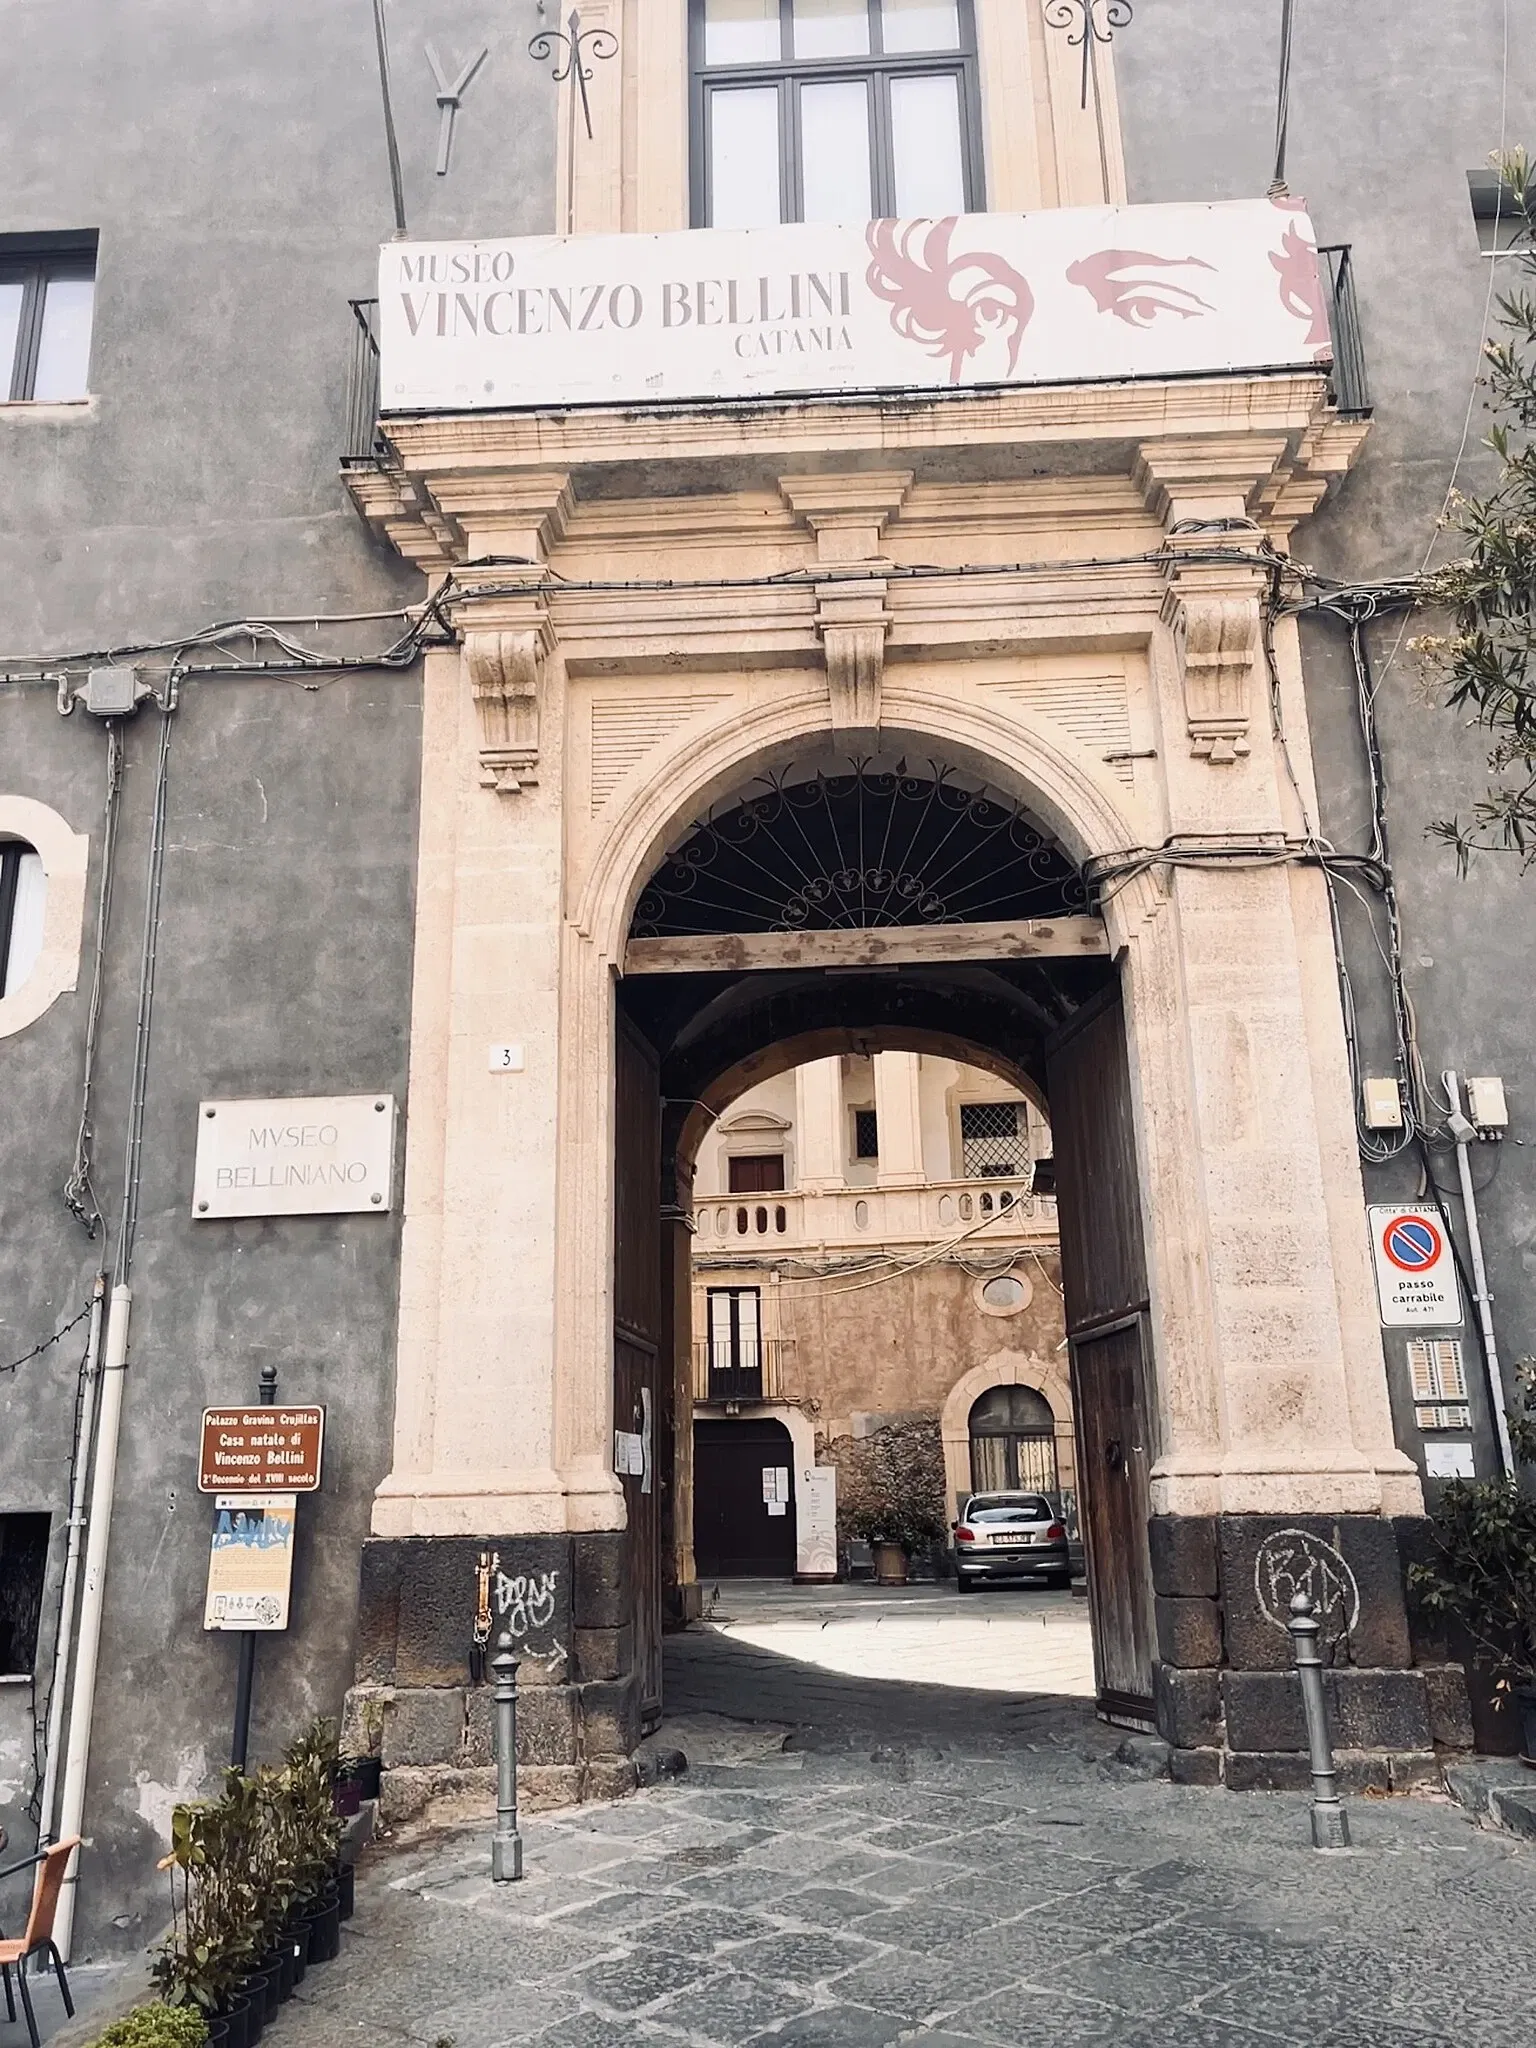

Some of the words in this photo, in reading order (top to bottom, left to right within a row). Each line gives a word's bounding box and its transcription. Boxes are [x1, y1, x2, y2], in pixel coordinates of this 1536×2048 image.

[400, 250, 515, 283] MUSEO
[400, 283, 643, 337] VINCENZO
[661, 271, 851, 328] BELLINI
[734, 325, 854, 359] CATANIA
[503, 1049, 511, 1066] 3
[249, 1125, 338, 1149] MVSEO
[216, 1162, 367, 1189] BELLINIANO
[1398, 1281, 1434, 1290] passo
[1392, 1293, 1444, 1303] carrabile
[206, 1415, 238, 1426] Palazzo
[242, 1414, 275, 1426] Gravina
[280, 1413, 318, 1427] Crujillas
[219, 1433, 244, 1447] Casa
[250, 1433, 285, 1446] natale
[291, 1432, 301, 1446] di
[214, 1451, 261, 1466] Vincenzo
[267, 1450, 305, 1465] Bellini
[248, 1473, 261, 1484] del
[288, 1472, 315, 1484] secolo
